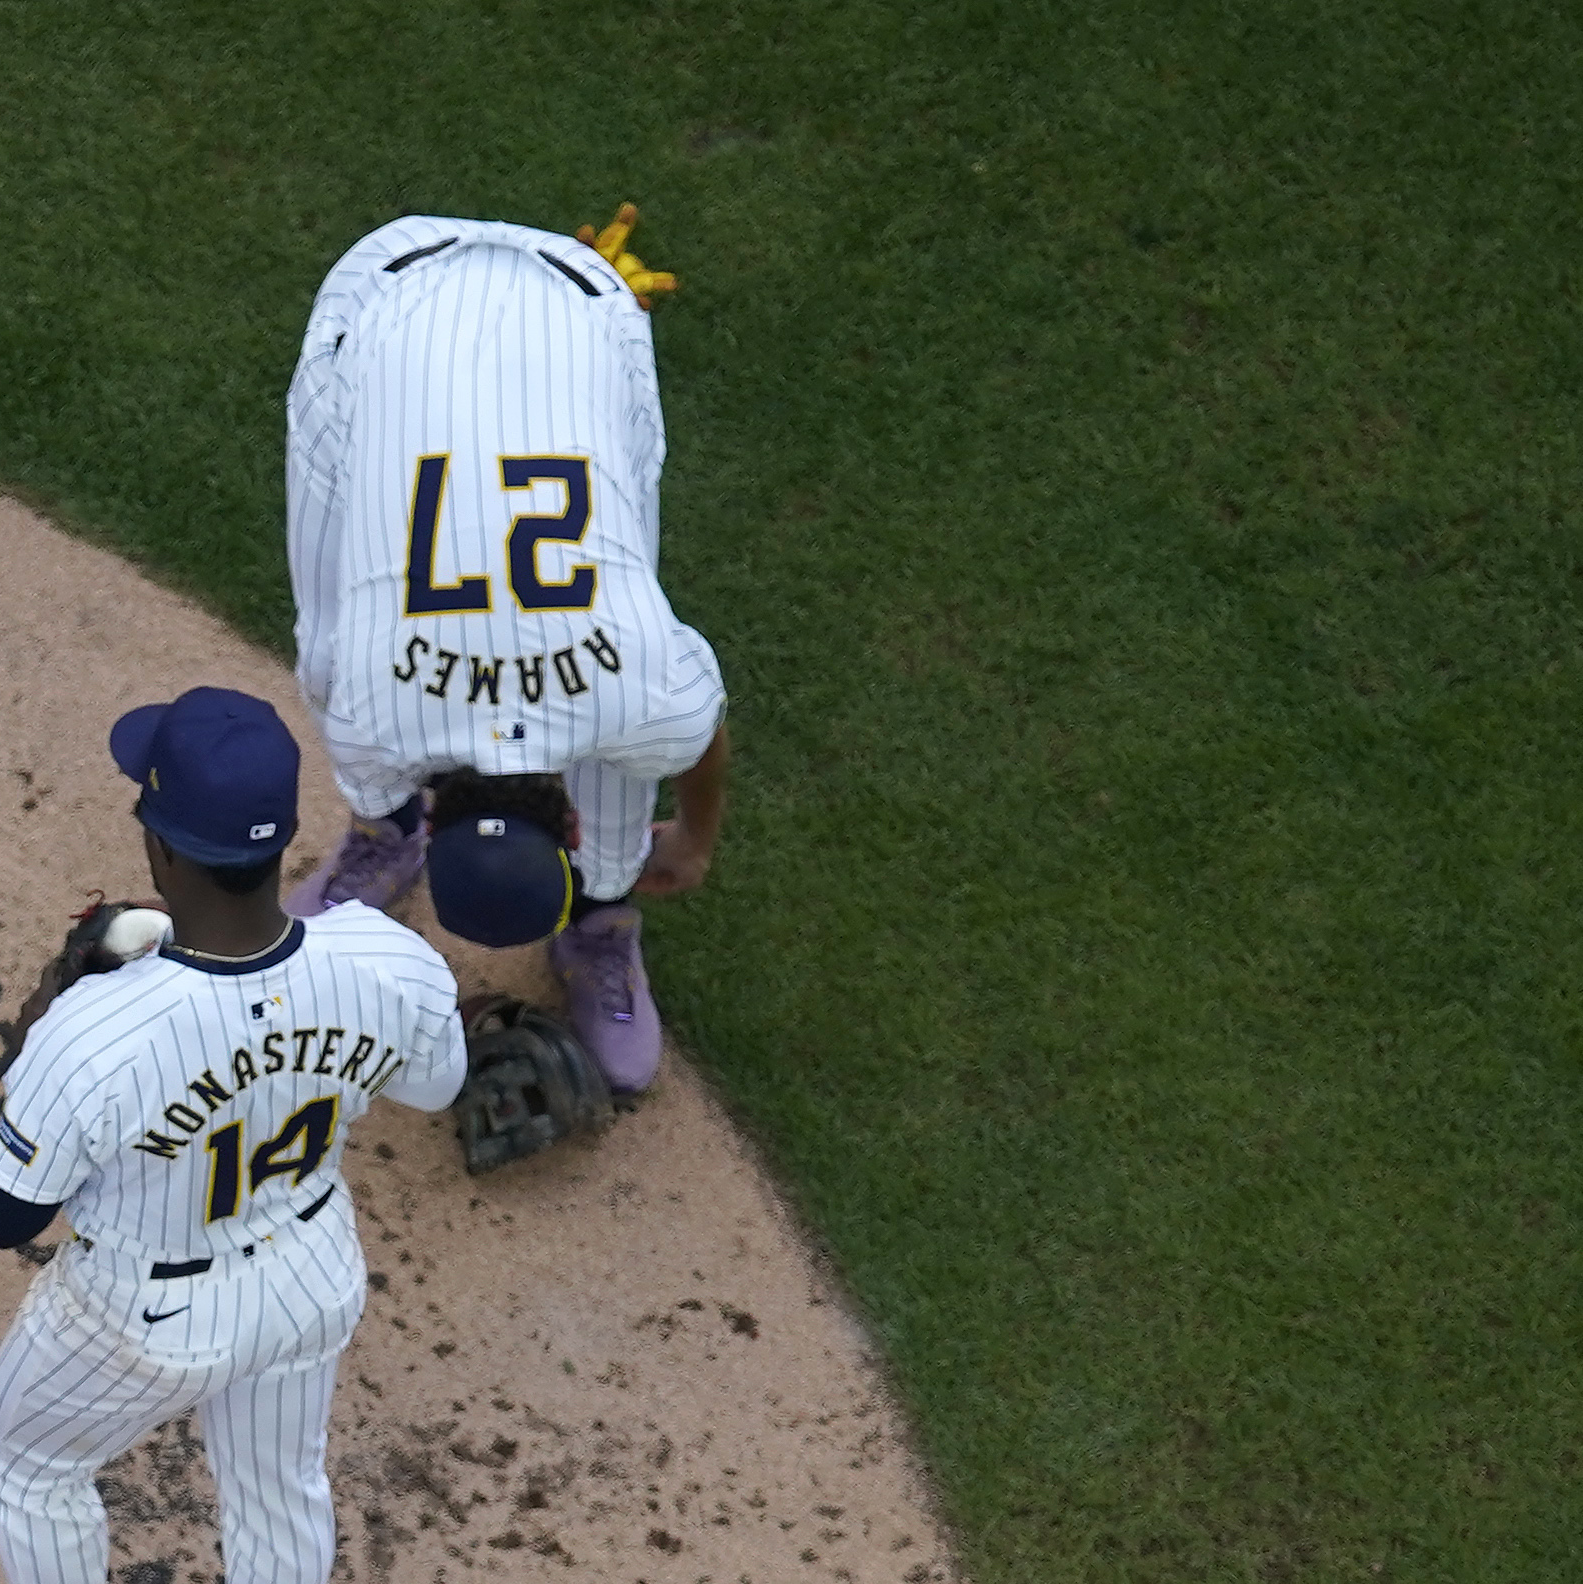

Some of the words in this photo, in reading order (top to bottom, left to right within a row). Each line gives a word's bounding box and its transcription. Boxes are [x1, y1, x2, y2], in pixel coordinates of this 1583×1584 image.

[403, 451, 598, 617] 27
[393, 626, 621, 705] ADAMES
[131, 1027, 404, 1161] MONASTERI
[204, 1094, 339, 1226] 14
